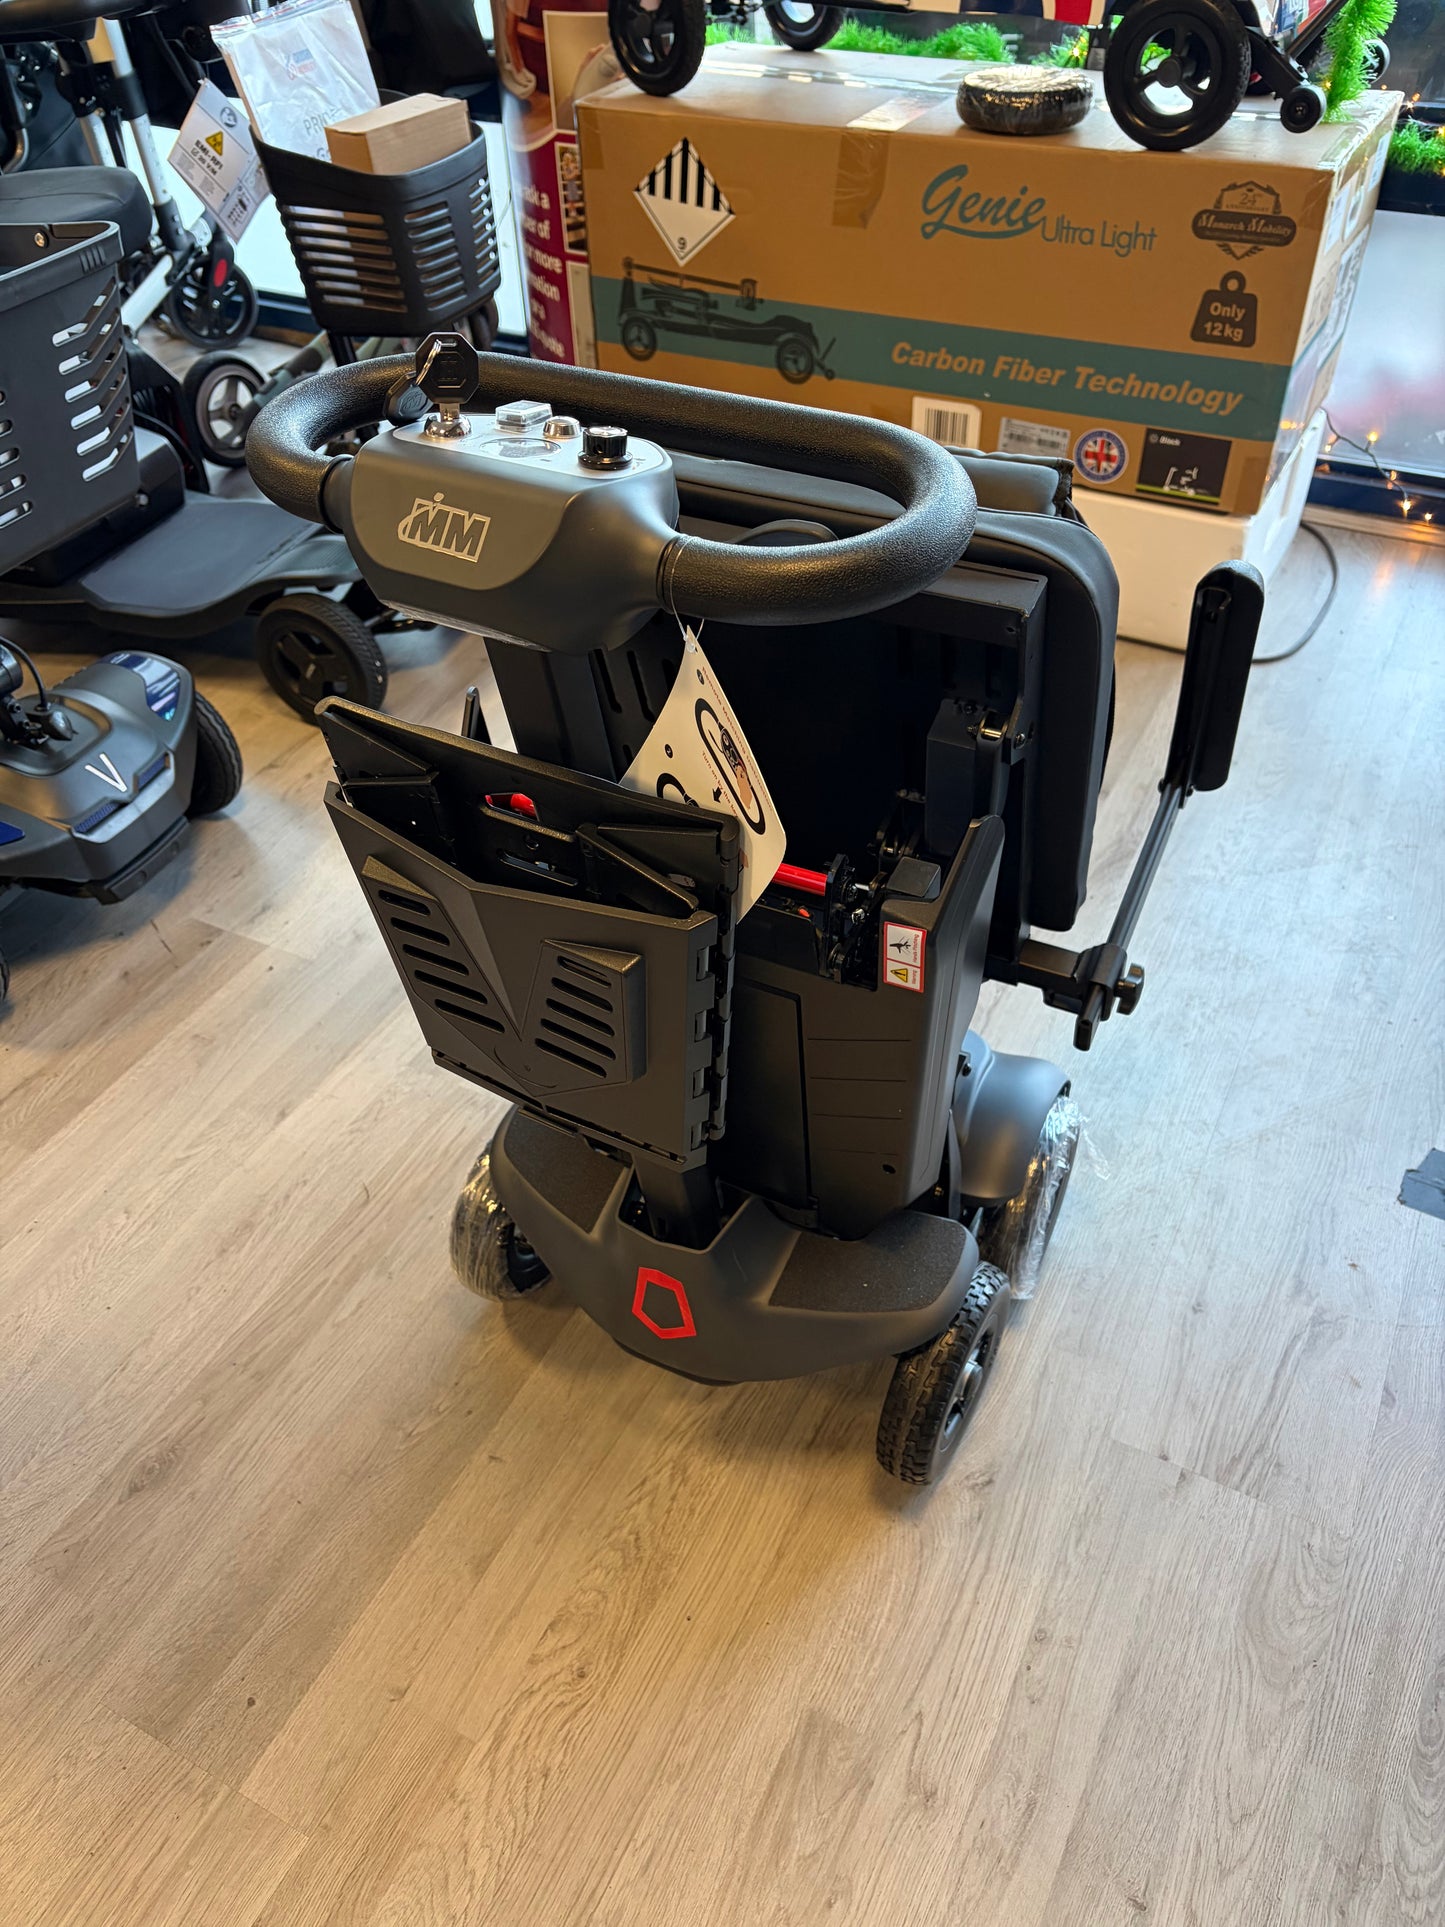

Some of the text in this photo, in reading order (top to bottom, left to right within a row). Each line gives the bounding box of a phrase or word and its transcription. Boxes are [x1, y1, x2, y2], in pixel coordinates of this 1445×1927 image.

[921, 164, 1158, 258] Genie Ultra Light
[677, 236, 687, 251] 9
[1209, 302, 1246, 321] Only
[1204, 321, 1244, 342] 12kg
[891, 342, 1244, 416] Carbon Fiber Technology
